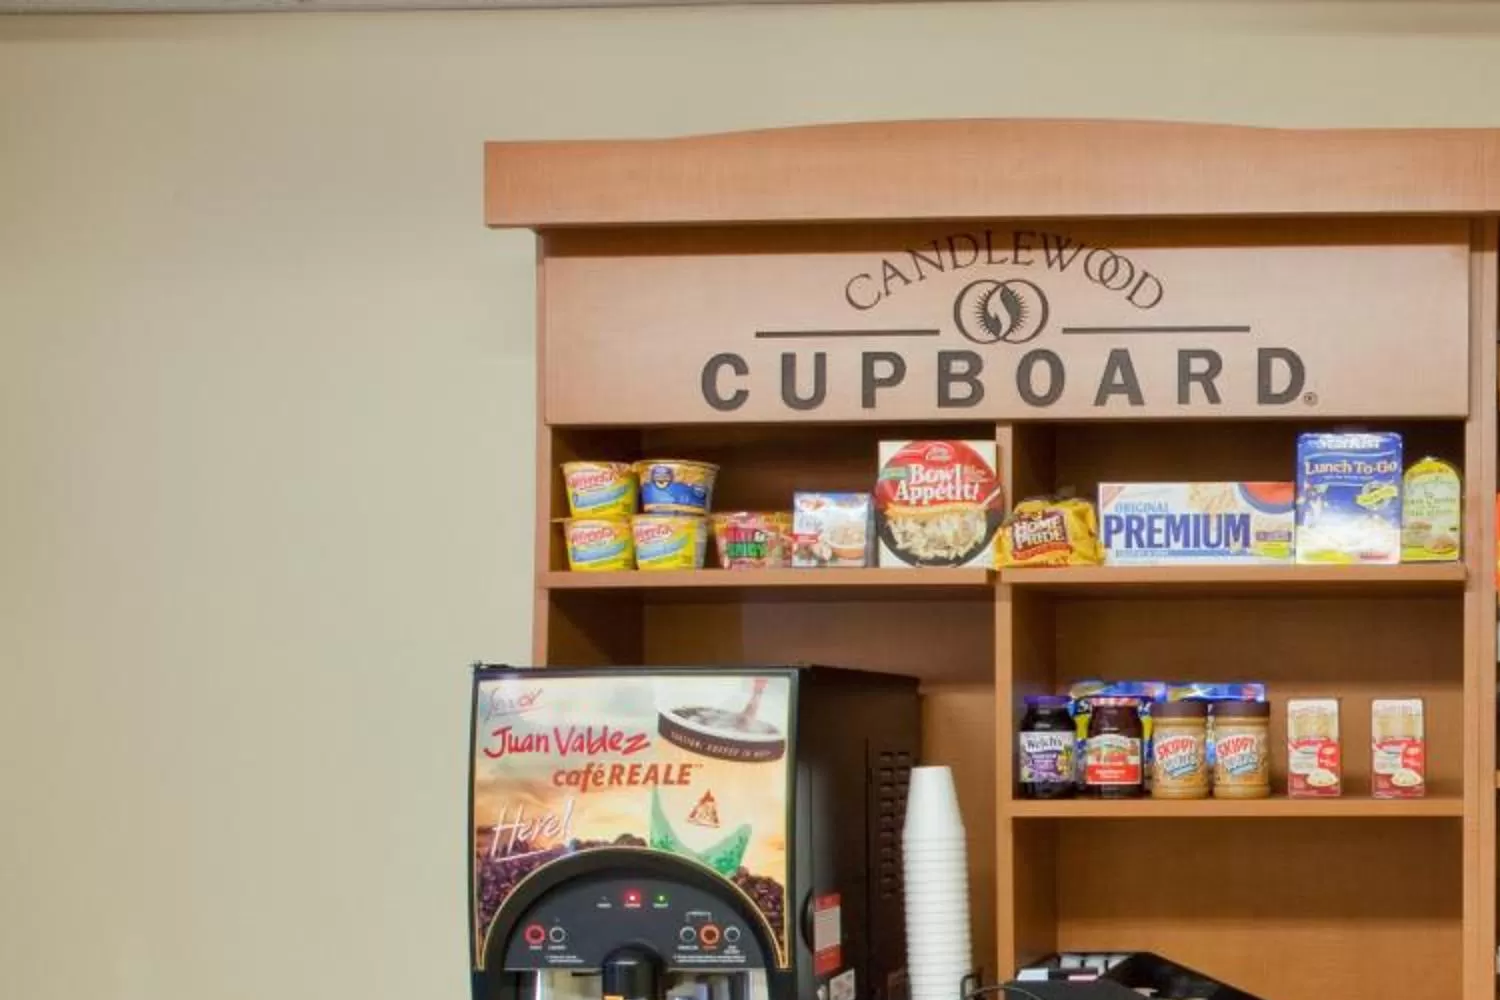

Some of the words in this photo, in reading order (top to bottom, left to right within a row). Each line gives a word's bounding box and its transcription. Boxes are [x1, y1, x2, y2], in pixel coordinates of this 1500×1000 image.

[845, 229, 1165, 312] CANDLEWOOD
[701, 346, 1307, 411] CUPBOARD
[911, 463, 961, 485] Bowl
[1304, 460, 1352, 476] Lunch
[1103, 513, 1250, 550] PREMIUM
[484, 725, 549, 759] Juan
[553, 724, 651, 757] Valdez
[553, 762, 605, 793] café
[608, 763, 692, 786] REALE
